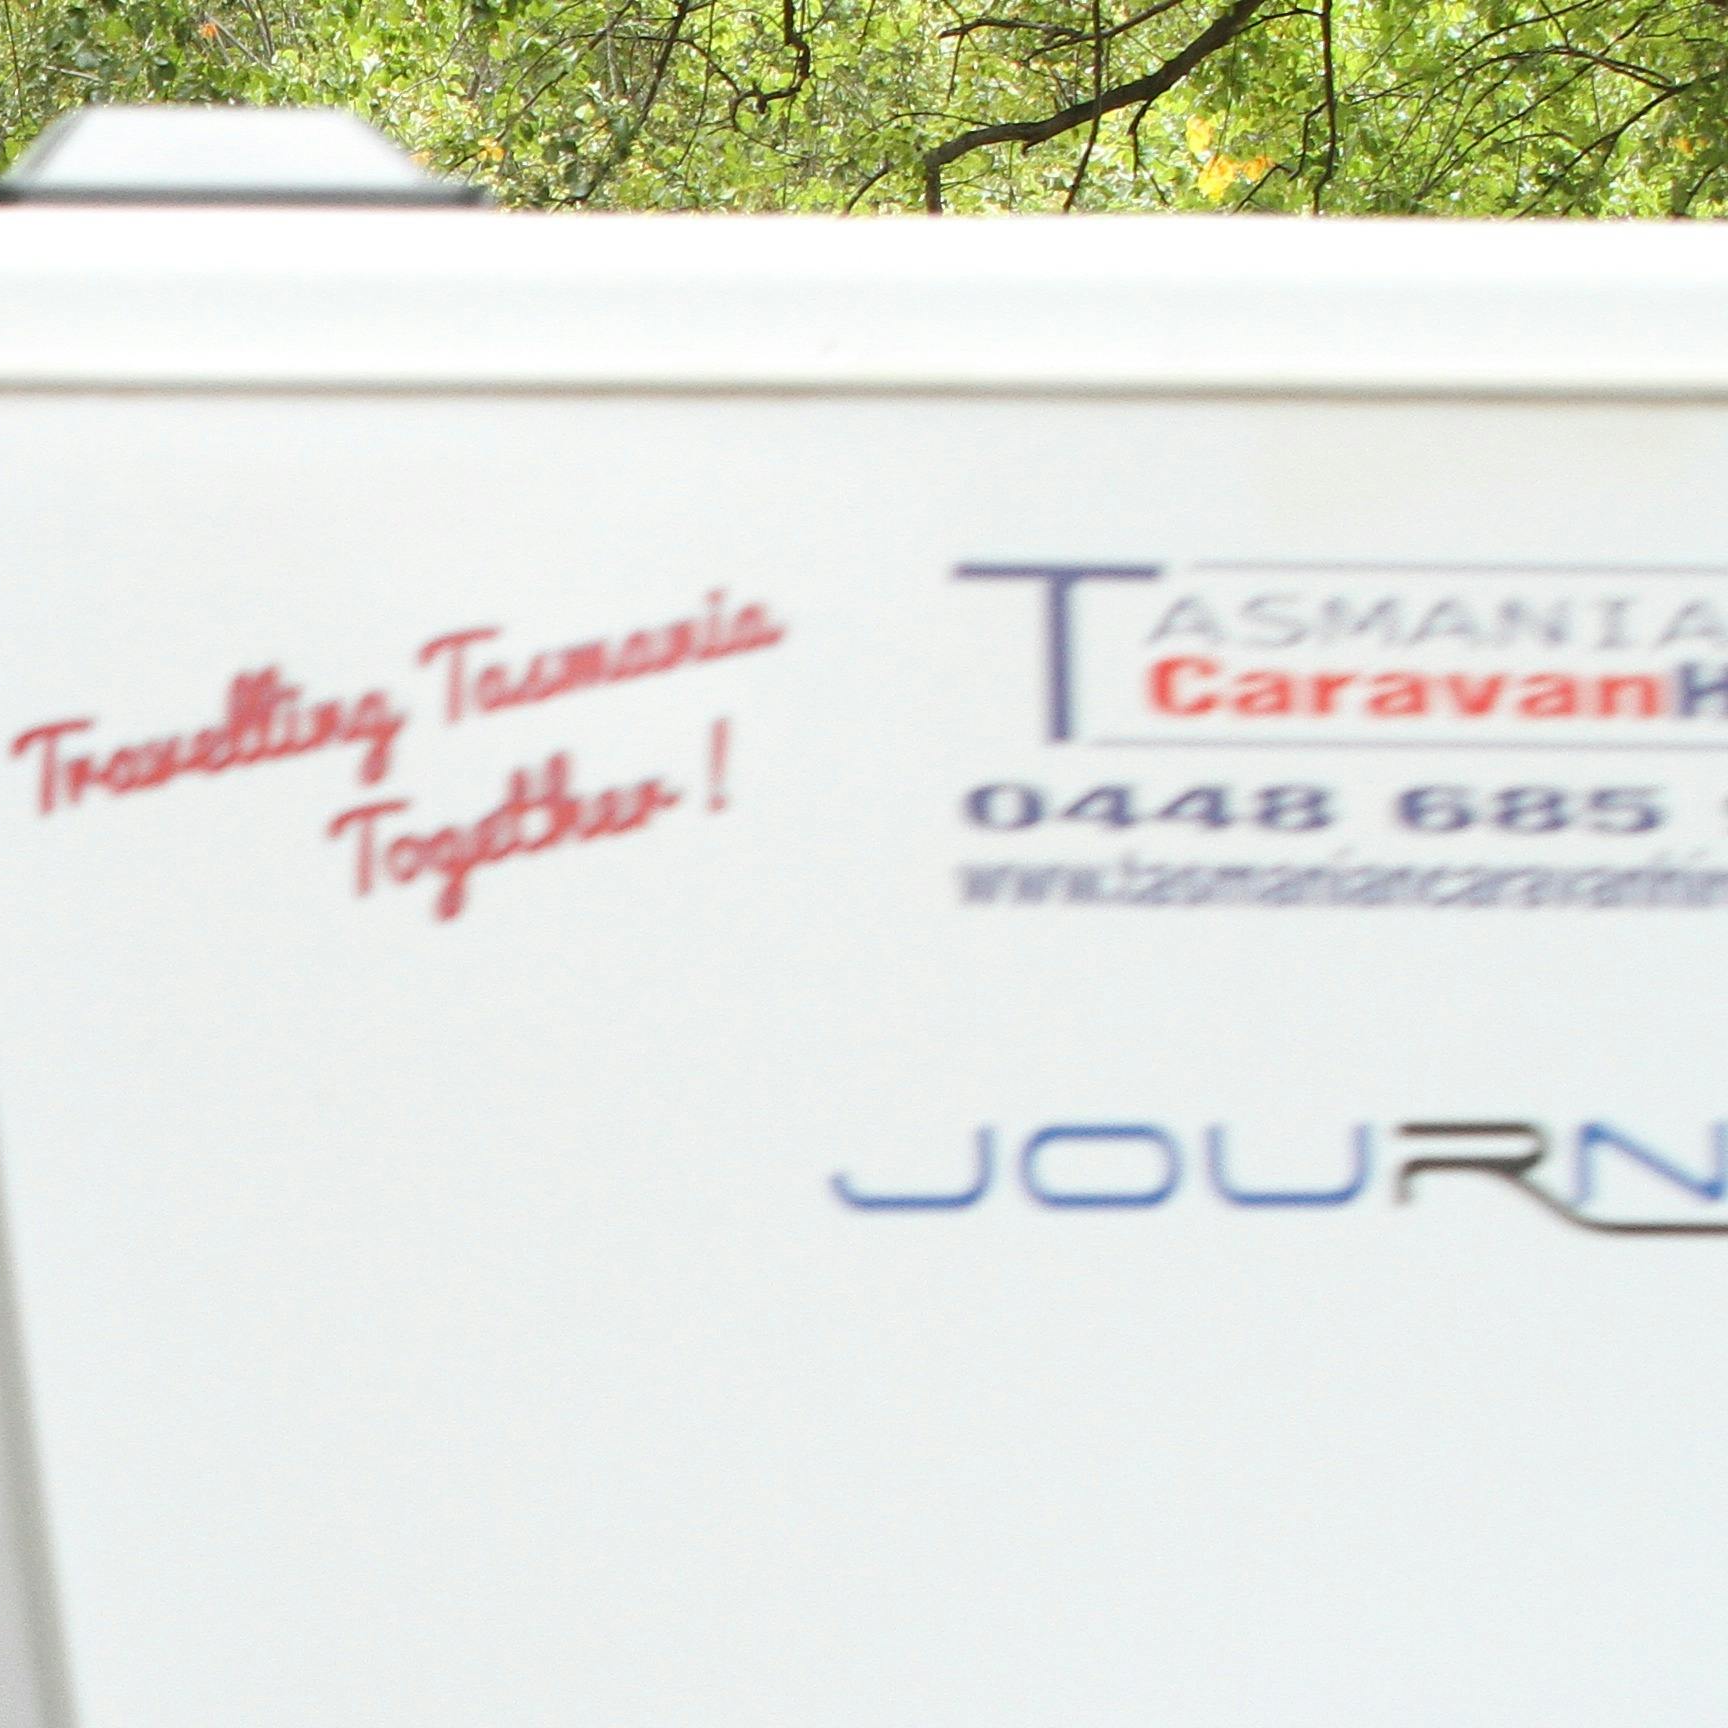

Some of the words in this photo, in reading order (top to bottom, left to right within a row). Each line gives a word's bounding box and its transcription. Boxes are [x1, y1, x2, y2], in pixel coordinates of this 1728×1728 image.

[417, 588, 787, 724] Tasmania
[327, 750, 682, 922] Together
[962, 782, 1340, 834] 0448
[1394, 784, 1670, 836] 685
